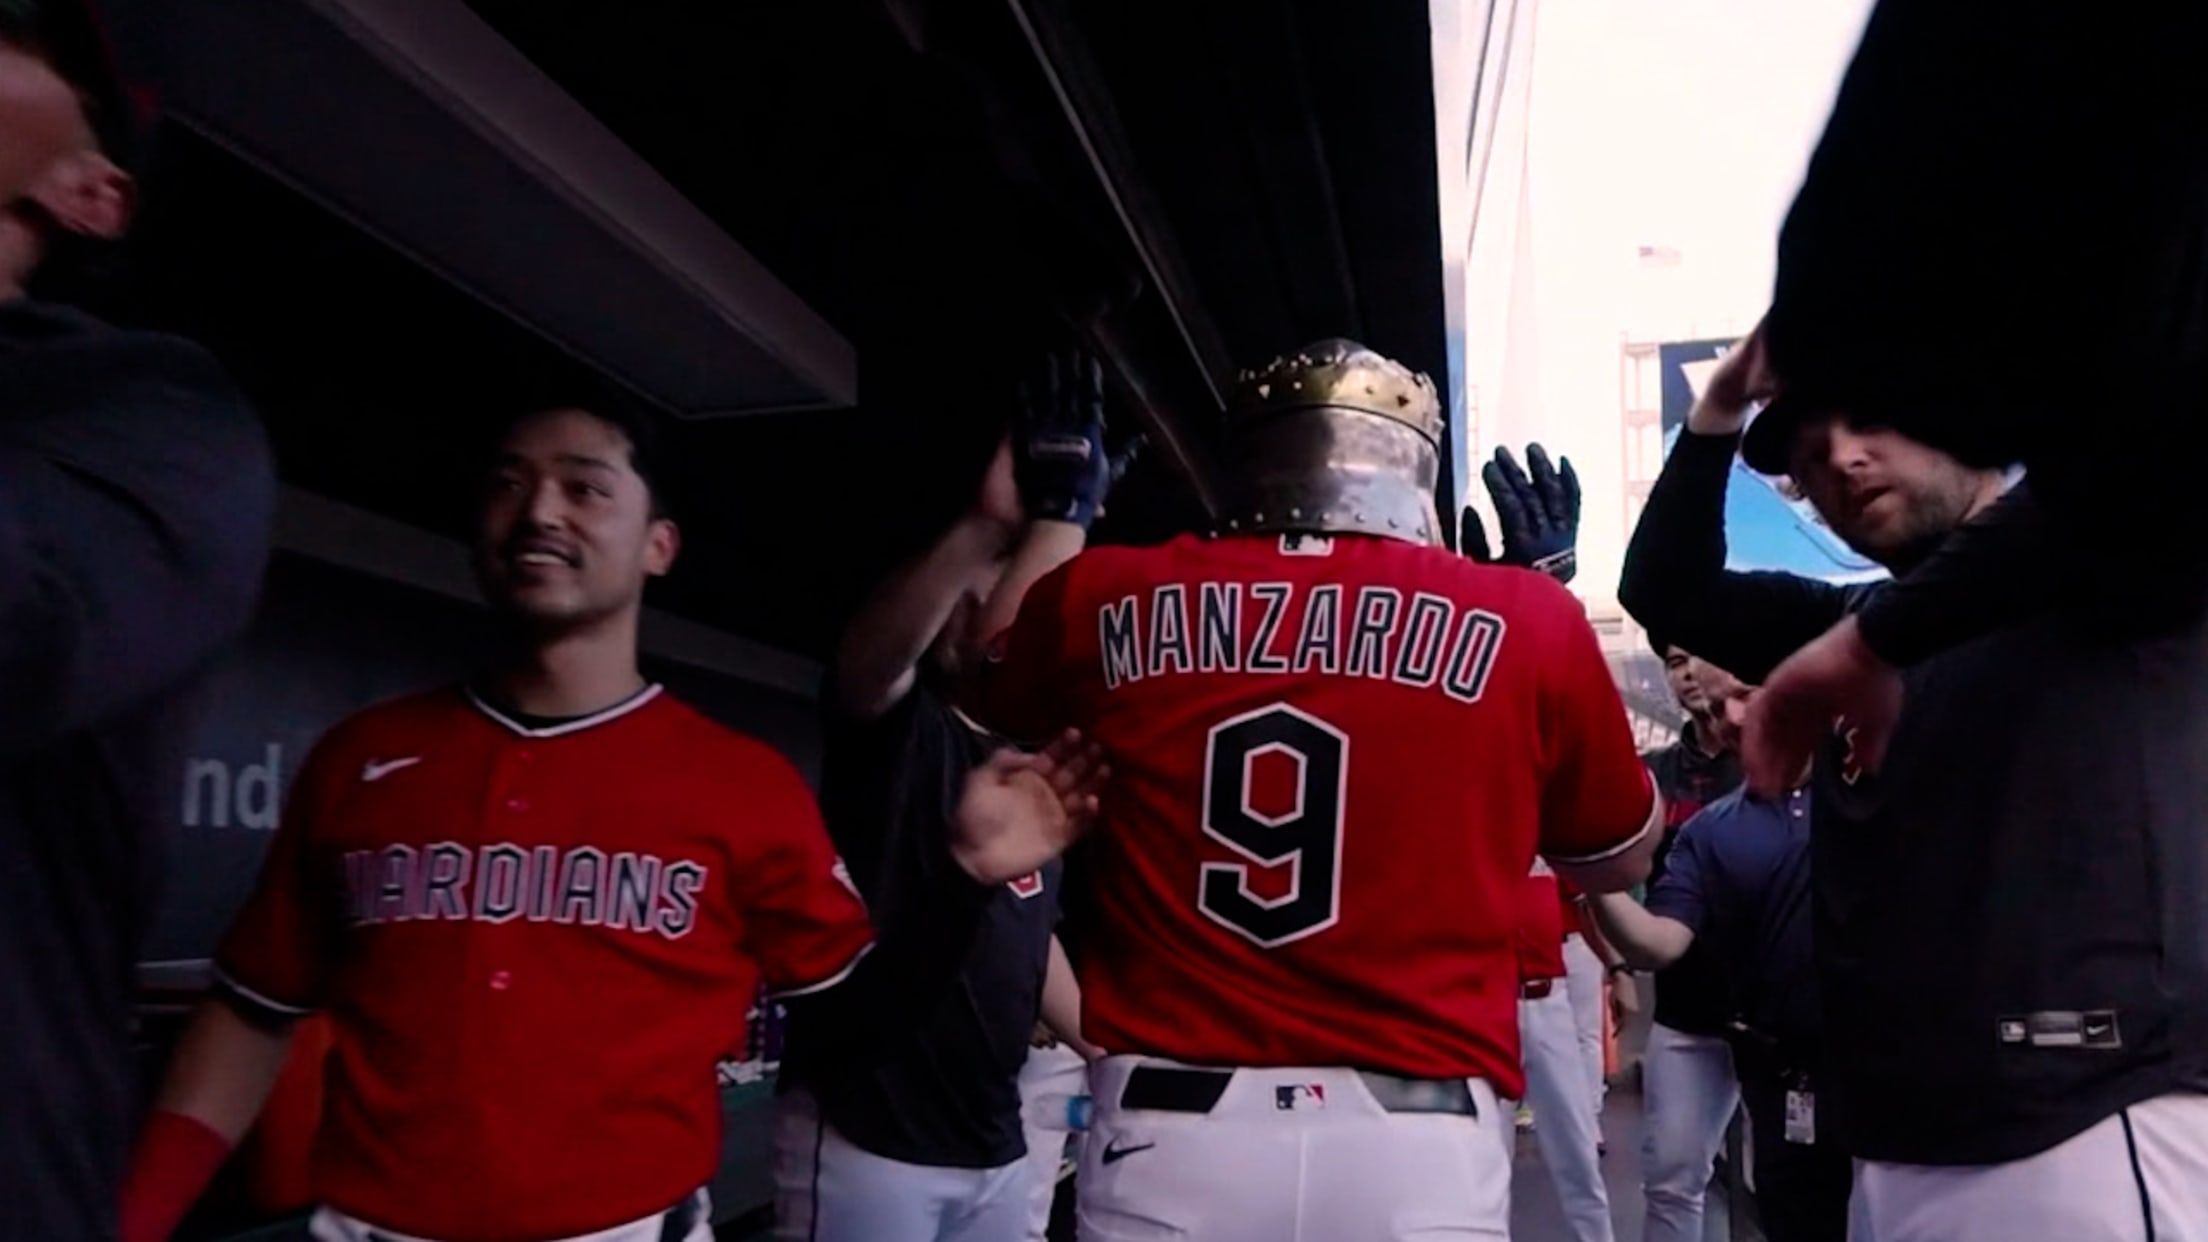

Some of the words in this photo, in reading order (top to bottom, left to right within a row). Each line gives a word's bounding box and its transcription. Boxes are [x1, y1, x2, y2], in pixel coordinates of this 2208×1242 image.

[1099, 582, 1507, 704] MANZARDO
[1198, 701, 1349, 949] 9
[340, 840, 709, 941] ARDIANS
